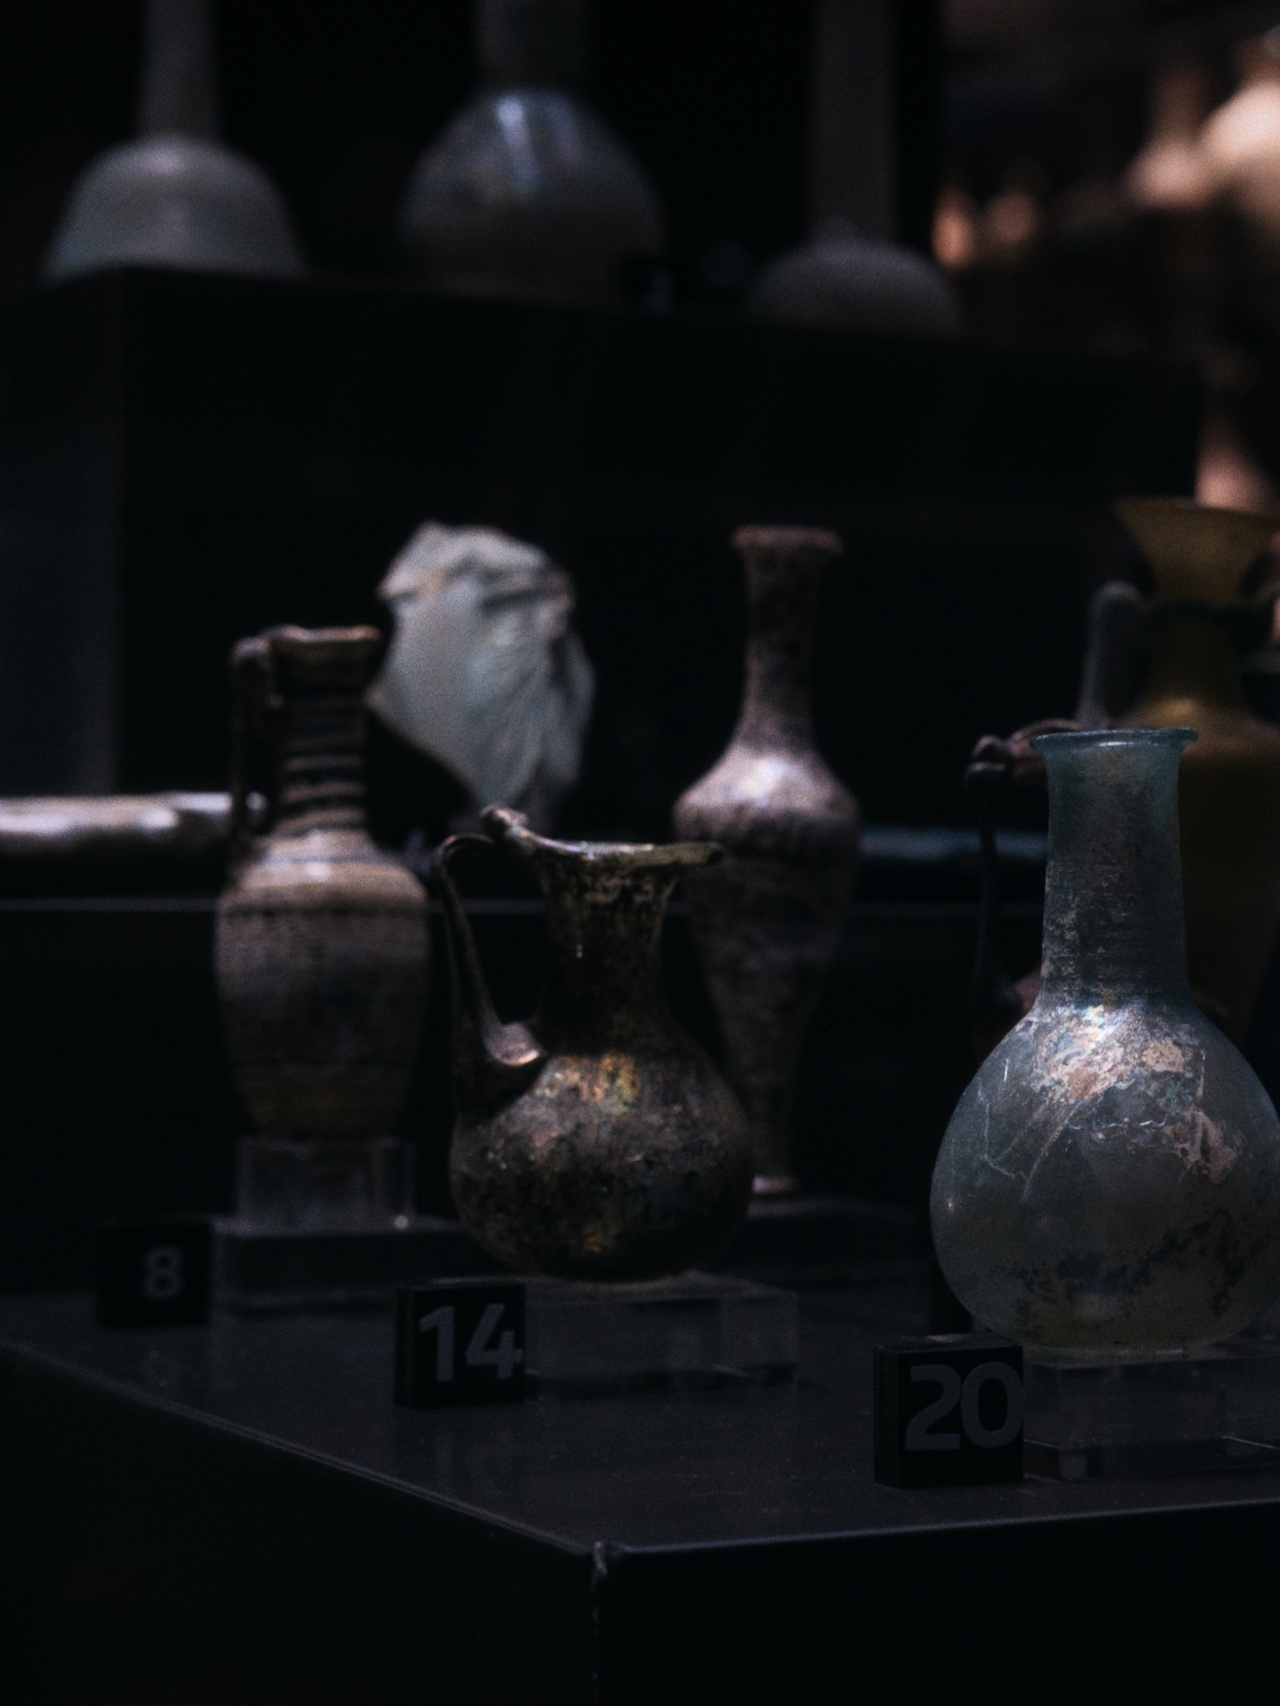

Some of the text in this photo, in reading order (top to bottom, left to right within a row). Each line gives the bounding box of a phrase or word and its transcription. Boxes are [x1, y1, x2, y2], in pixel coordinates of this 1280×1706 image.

[140, 1243, 187, 1301] 8
[418, 1302, 524, 1383] 14
[904, 1361, 1024, 1452] 20
